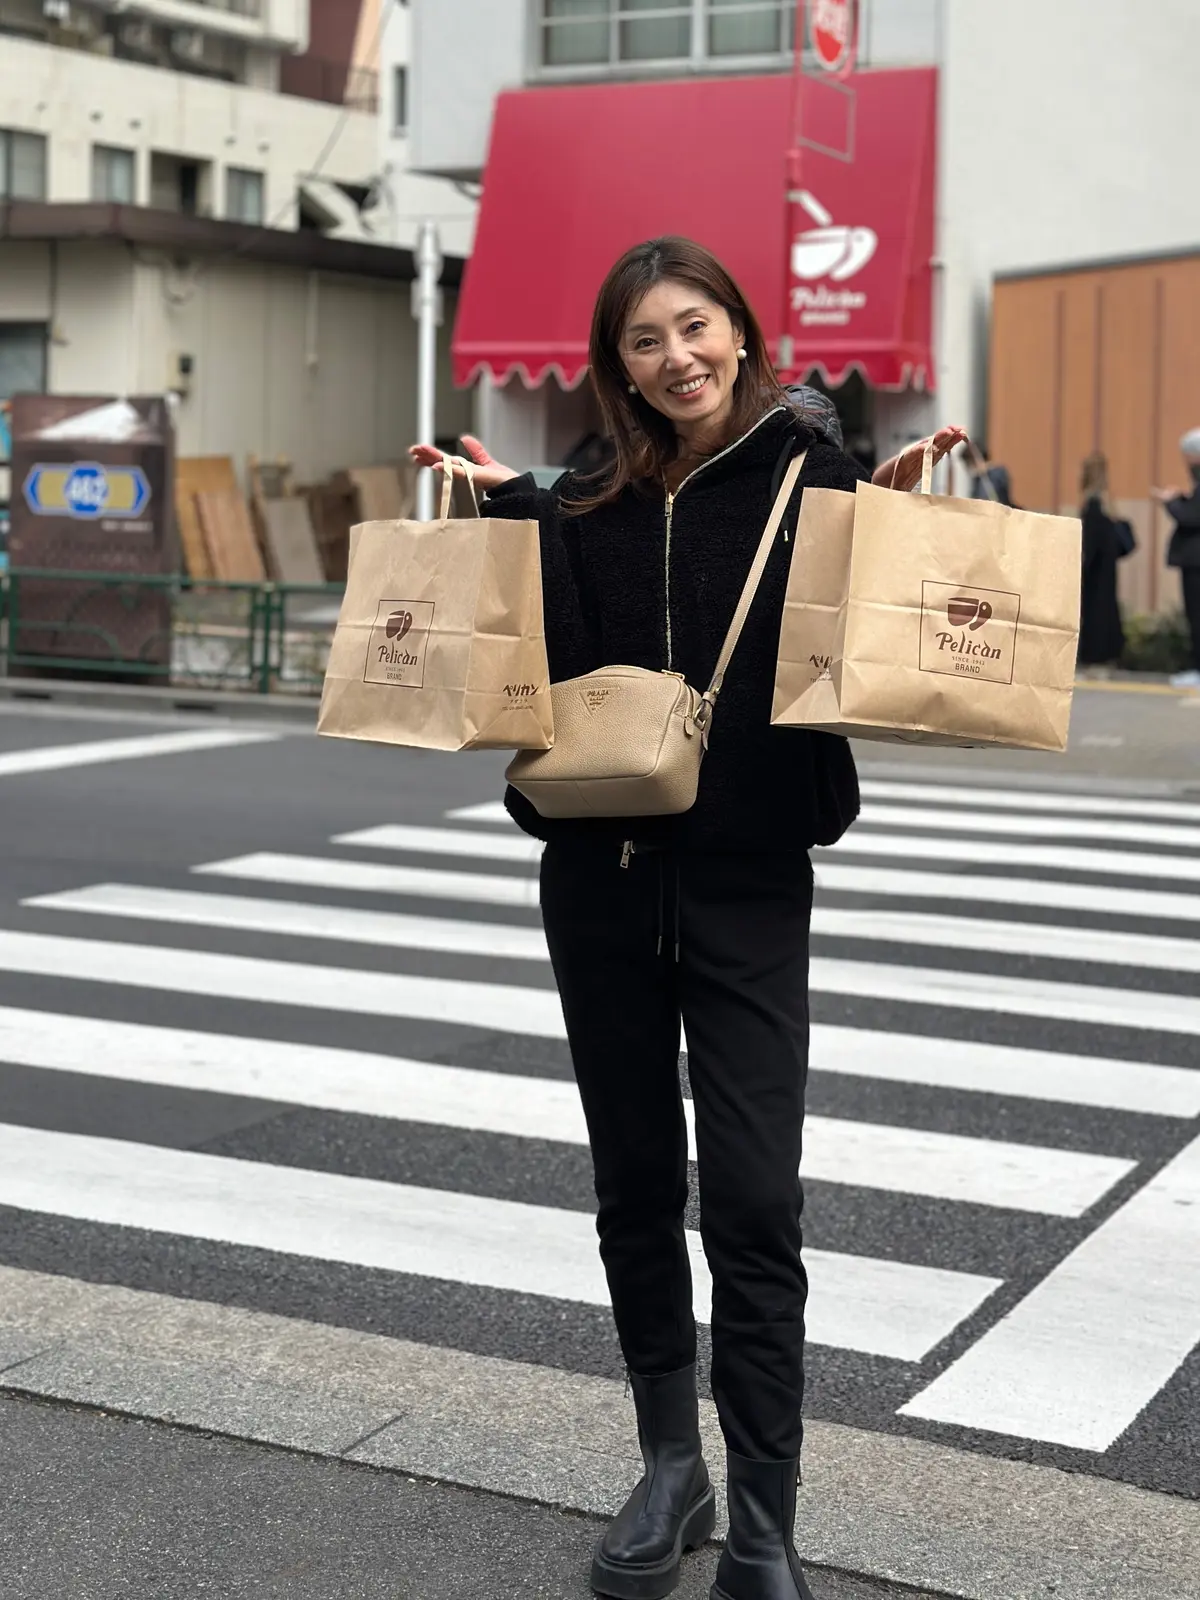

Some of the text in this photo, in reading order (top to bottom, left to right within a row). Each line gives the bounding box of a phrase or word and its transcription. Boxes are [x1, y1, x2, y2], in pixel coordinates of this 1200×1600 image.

[935, 630, 1002, 660] Pelican
[378, 642, 418, 666] Pelican
[952, 655, 969, 663] SINCE
[955, 663, 981, 674] BRAND
[387, 673, 402, 681] BRAND
[503, 684, 539, 696] ペリカン
